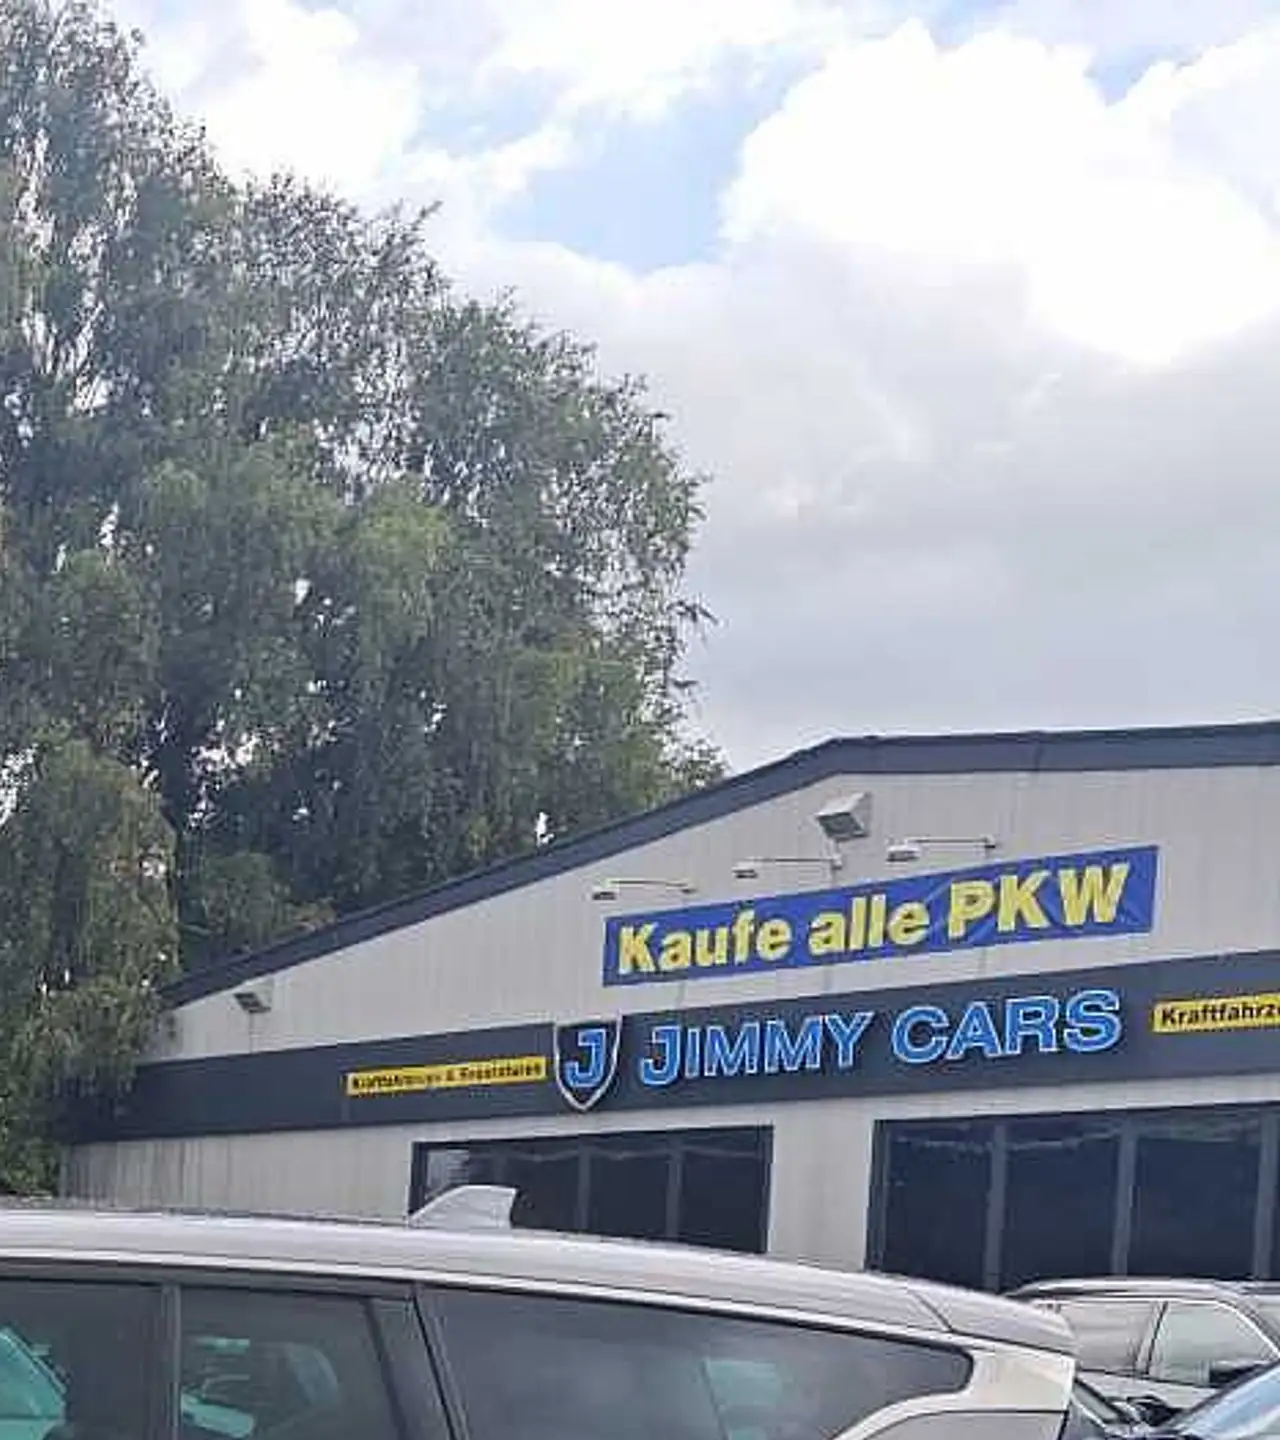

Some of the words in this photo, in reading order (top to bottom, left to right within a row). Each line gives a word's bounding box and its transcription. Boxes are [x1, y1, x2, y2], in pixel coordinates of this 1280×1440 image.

[617, 910, 790, 975] Kaufe
[808, 895, 932, 956] alle
[947, 863, 1130, 940] PKW
[566, 1028, 608, 1089] J
[640, 1011, 875, 1087] JIMMY
[891, 988, 1122, 1065] CARS
